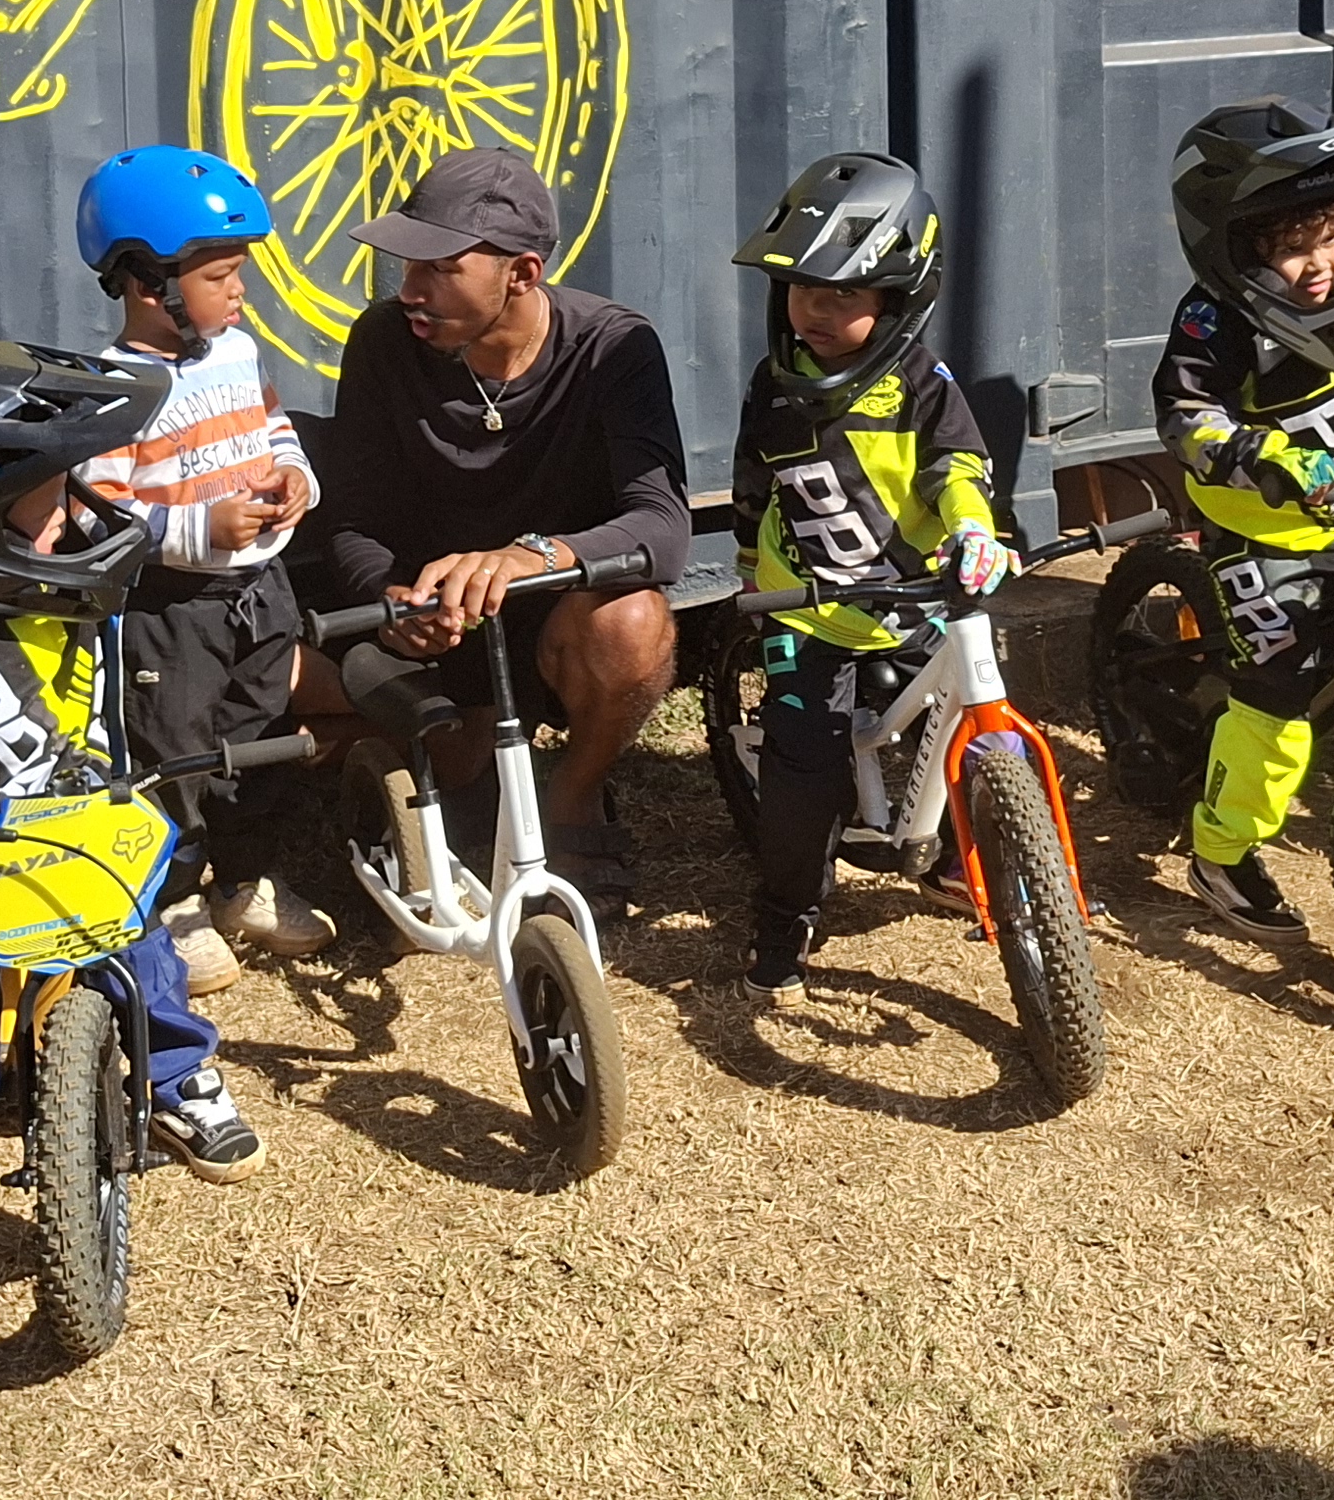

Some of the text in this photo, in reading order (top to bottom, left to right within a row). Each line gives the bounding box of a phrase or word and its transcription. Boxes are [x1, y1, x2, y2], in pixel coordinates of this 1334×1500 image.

[157, 383, 258, 443] OCEAN LEAGUE
[176, 431, 227, 479] Best
[1218, 560, 1298, 666] PPA
[7, 798, 91, 826] INSIGHT
[113, 1193, 129, 1281] CROWN
